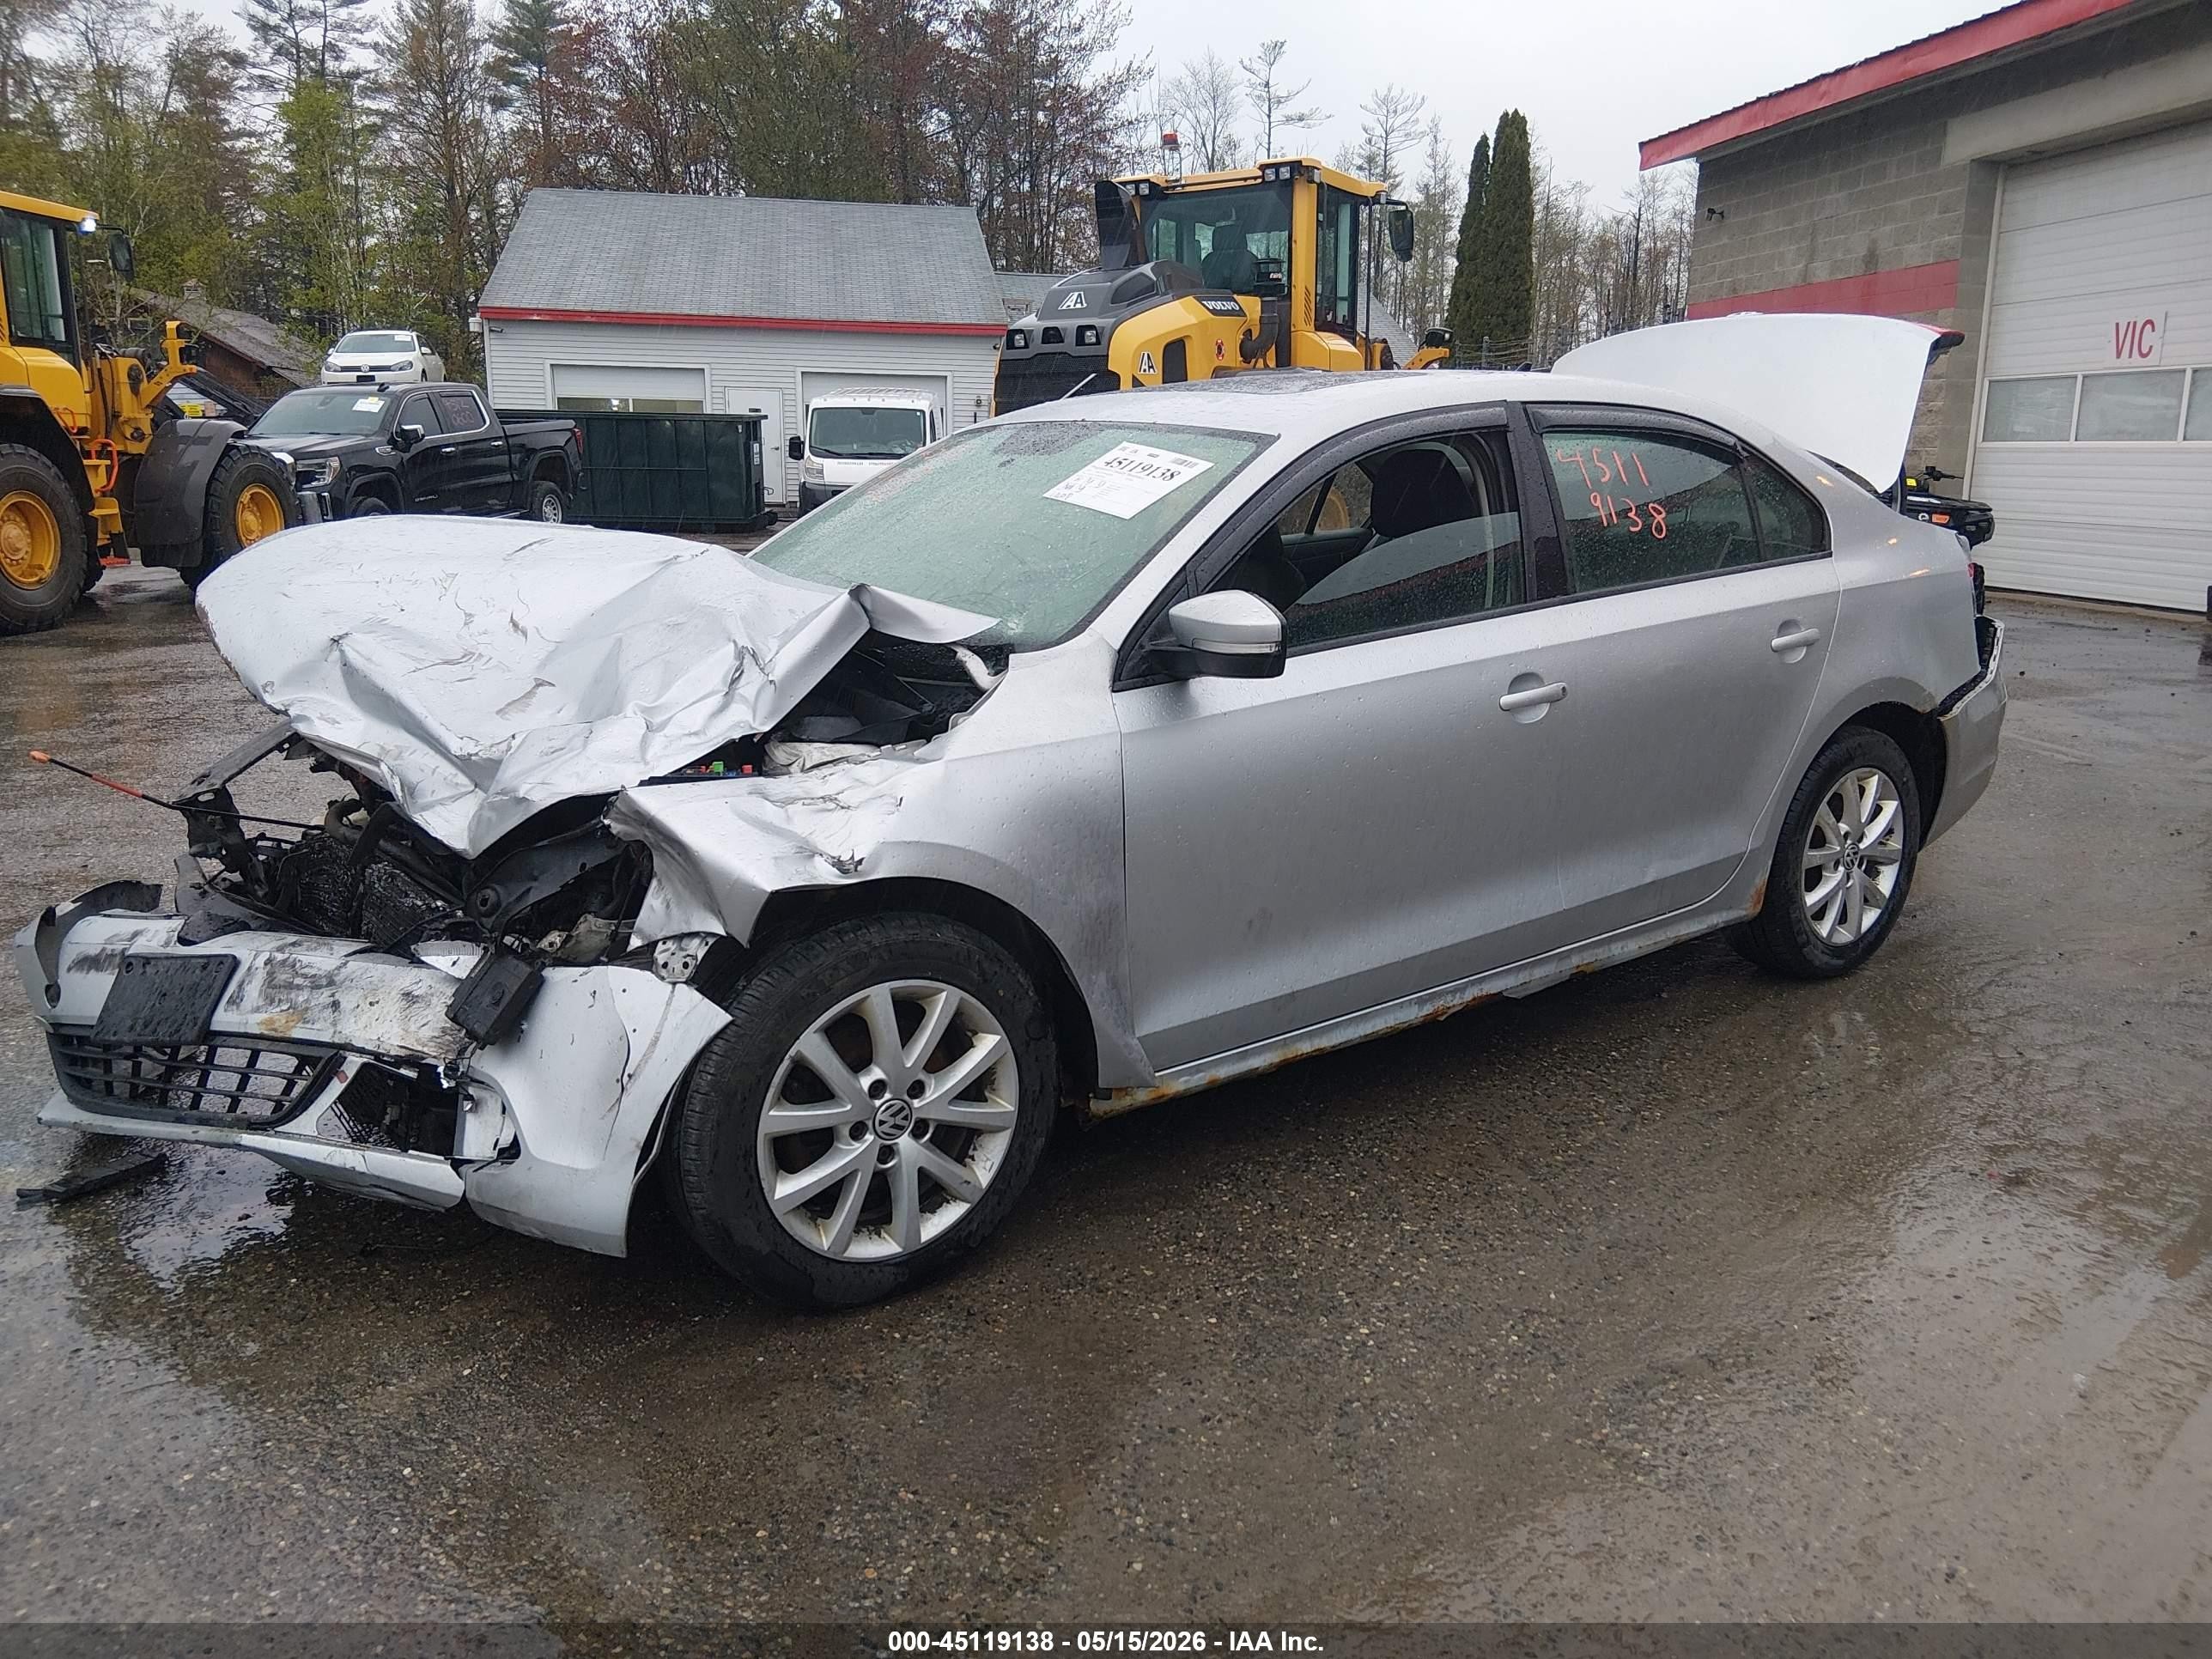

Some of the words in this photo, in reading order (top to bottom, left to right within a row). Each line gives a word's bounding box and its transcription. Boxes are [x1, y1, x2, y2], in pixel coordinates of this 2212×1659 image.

[1201, 301, 1240, 311] VOLVO
[2115, 319, 2156, 359] VIC
[1103, 456, 1182, 482] 45119138
[1556, 447, 1650, 489] 4511
[1589, 492, 1667, 539] 9138
